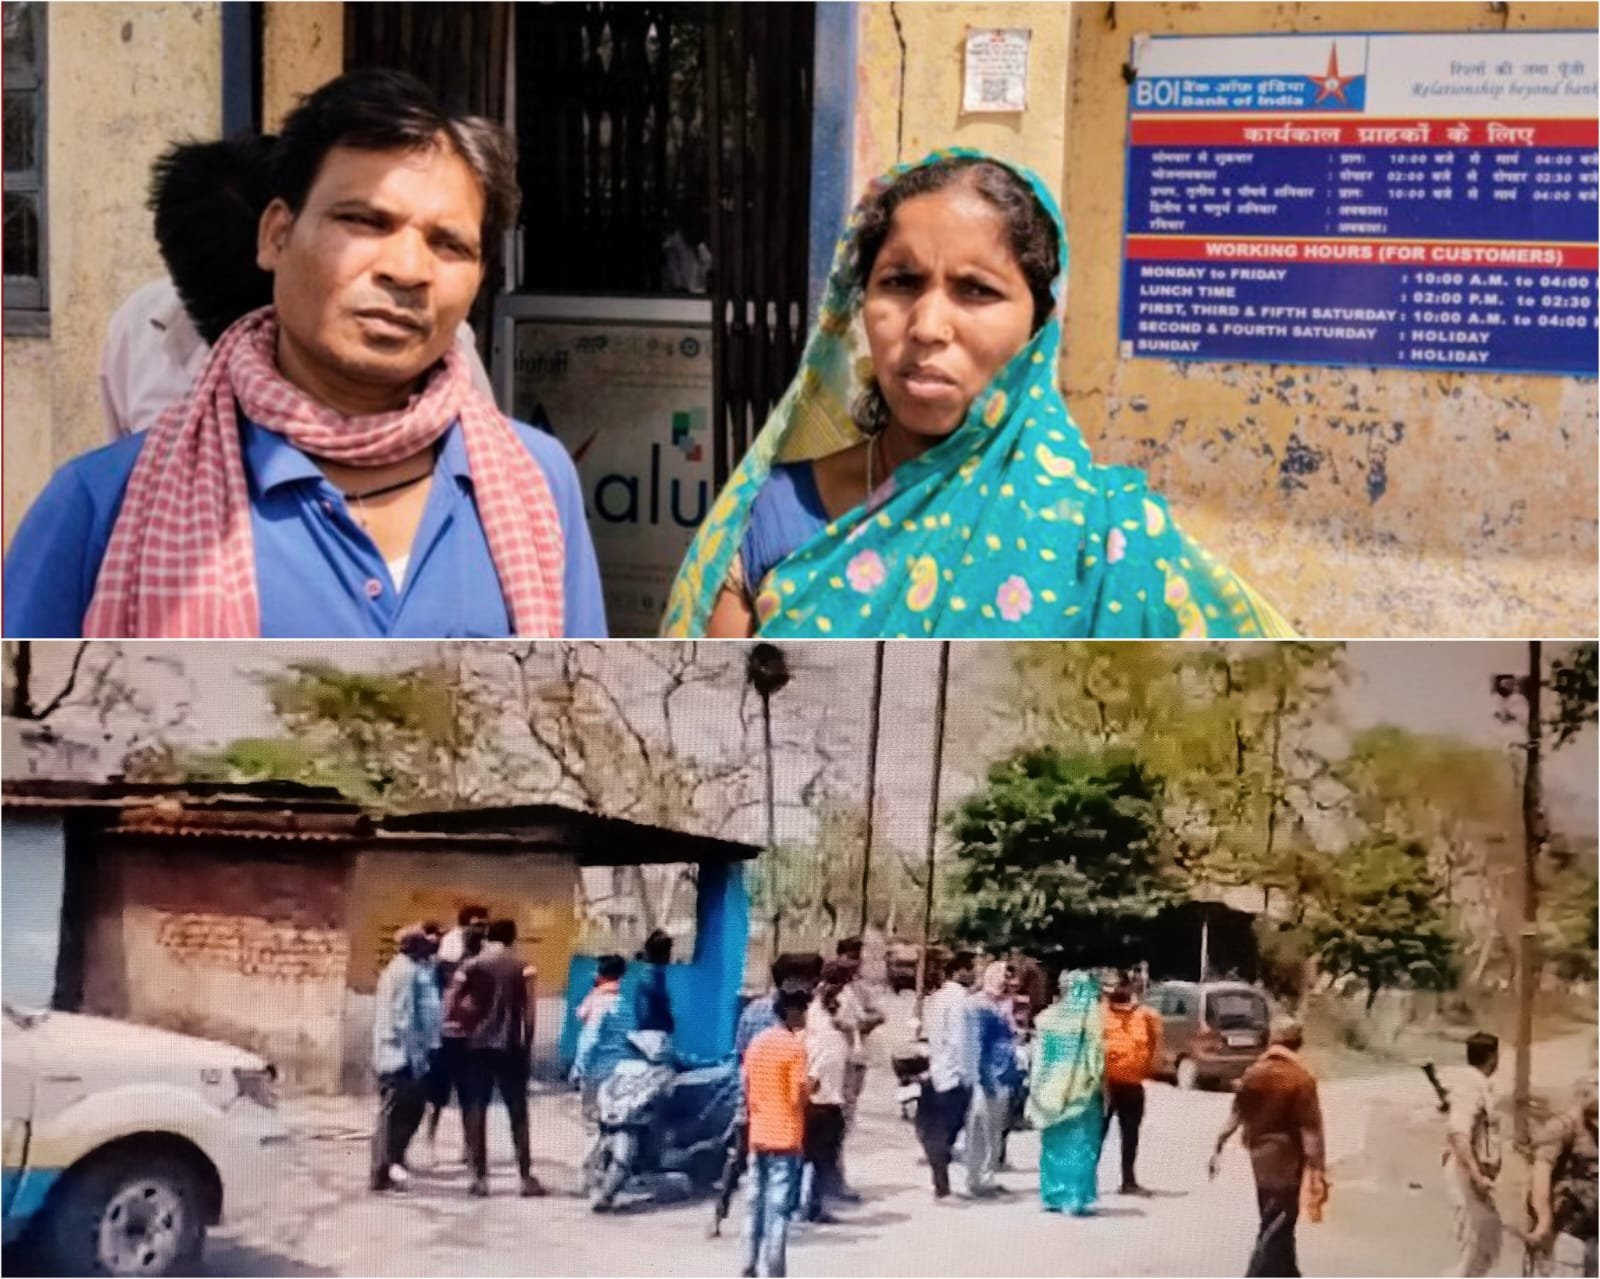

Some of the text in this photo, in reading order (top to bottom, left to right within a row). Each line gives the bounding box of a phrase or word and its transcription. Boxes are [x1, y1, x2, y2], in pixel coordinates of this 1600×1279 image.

[1137, 80, 1180, 106] BOI
[1182, 80, 1210, 93] बैंक
[1257, 79, 1305, 95] इंडिया
[1411, 82, 1504, 99] Relationship
[1509, 80, 1558, 99] beyond
[1181, 95, 1305, 107] Bank of India
[1242, 122, 1342, 143] कार्यकाल
[1446, 122, 1470, 144] के
[1487, 123, 1536, 146] लिए
[1390, 154, 1427, 164] 10:00
[1535, 154, 1573, 165] 04:00
[1387, 171, 1424, 181] 02:00
[1535, 172, 1573, 183] 02:30
[1388, 189, 1425, 199] 10:00
[1533, 190, 1571, 200] 04:00
[1205, 242, 1563, 267] WORKING HOURS (FOR CUSTOMERS)
[1140, 266, 1206, 279] MONDAY
[1210, 268, 1226, 279] to
[1230, 268, 1287, 281] FRIDAY
[1414, 272, 1463, 285] 10:00
[1469, 274, 1509, 287] A.M.
[1515, 275, 1533, 287] to
[1540, 276, 1589, 289] 04:00
[1140, 285, 1193, 297] LUNCH
[1198, 286, 1236, 298] TIME
[1412, 291, 1462, 304] 02:00
[1469, 293, 1504, 305] P.M.
[1517, 295, 1535, 307] to
[1541, 296, 1591, 308] 02:30
[1139, 303, 1187, 316] FIRST,
[1192, 304, 1239, 316] THIRD
[1244, 306, 1256, 317] &
[1261, 306, 1307, 318] FIFTH
[1312, 308, 1397, 321] SATURDAY
[1413, 310, 1461, 324] 10:00
[1468, 312, 1506, 325] A.M.
[1513, 314, 1531, 326] to
[1538, 315, 1587, 328] 04:00
[1138, 321, 1202, 334] SECOND
[1206, 323, 1218, 334] &
[1223, 324, 1287, 337] FOURTH
[1292, 326, 1377, 339] SATURDAY
[1411, 330, 1490, 344] HOLIDAY
[1137, 339, 1200, 352] SUNDAY
[1410, 349, 1490, 363] HOLIDAY
